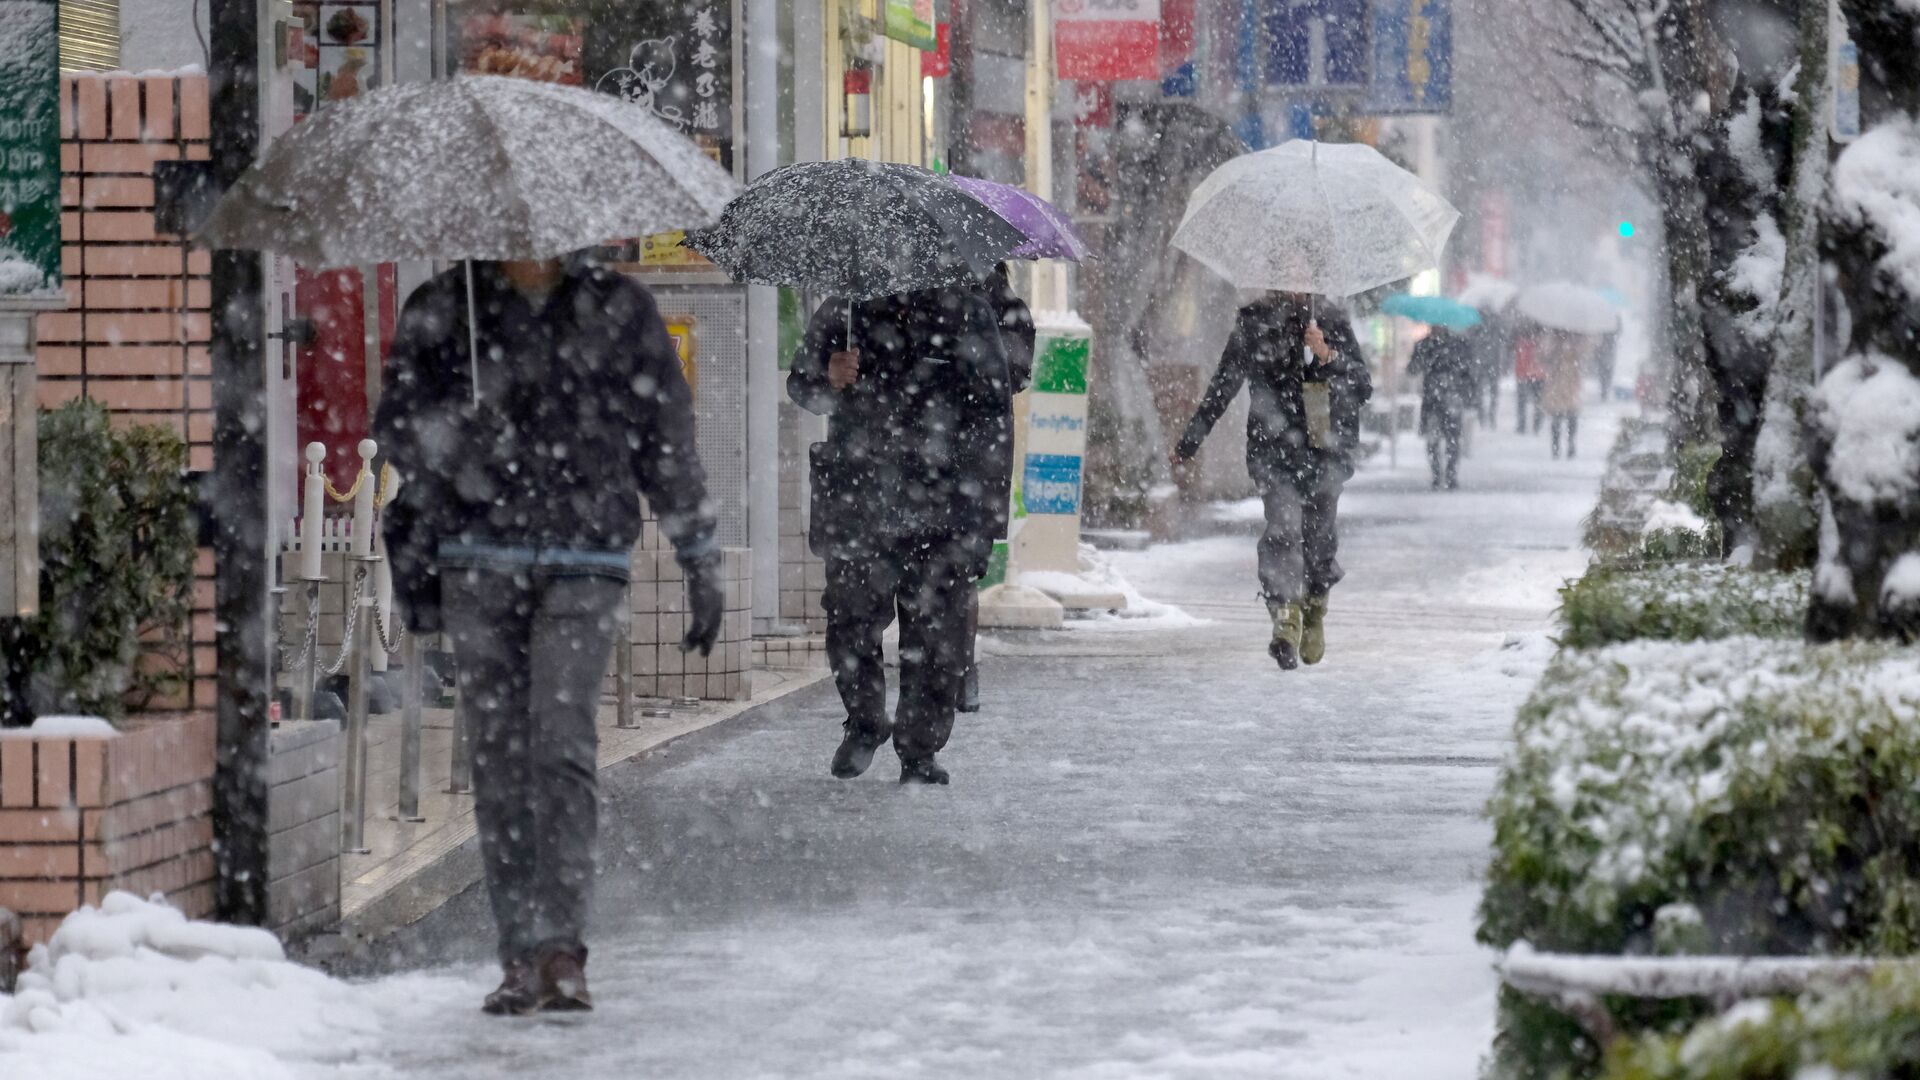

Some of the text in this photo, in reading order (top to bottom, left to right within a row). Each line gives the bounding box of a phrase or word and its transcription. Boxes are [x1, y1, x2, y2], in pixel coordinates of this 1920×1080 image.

[690, 5, 718, 129] 養老乃瀧
[0, 116, 42, 140] pm
[1031, 412, 1083, 433] FamilyMart
